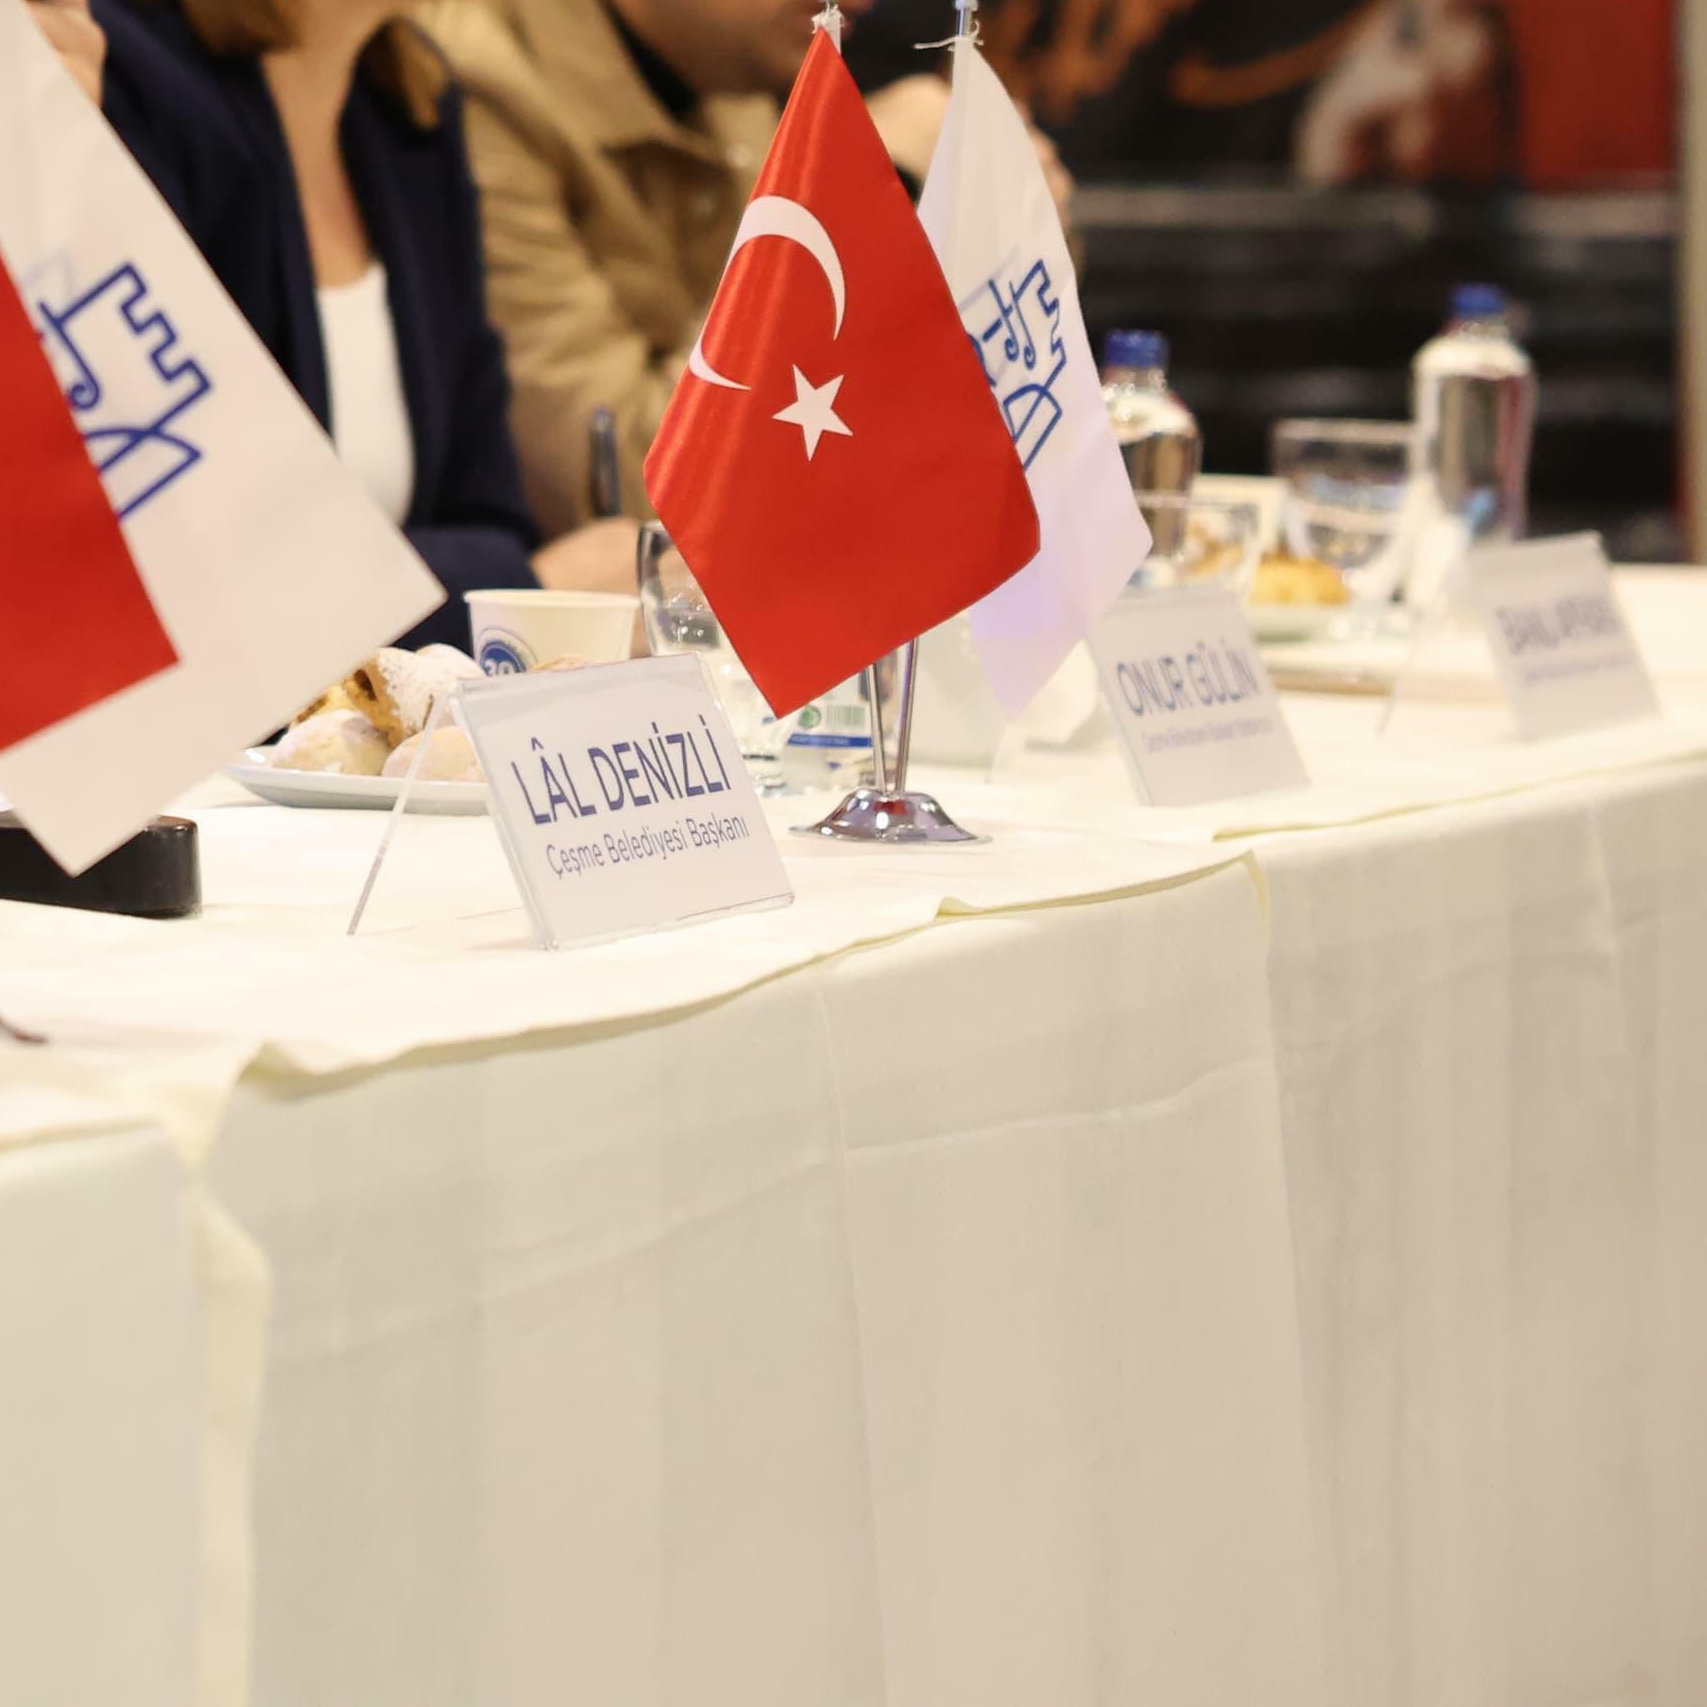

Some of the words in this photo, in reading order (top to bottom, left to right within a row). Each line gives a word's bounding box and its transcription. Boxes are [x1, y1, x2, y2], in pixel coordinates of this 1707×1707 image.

[1116, 656, 1195, 717] ONUR
[511, 737, 597, 825] LÂL
[587, 714, 731, 811] DENİZLİ
[546, 844, 605, 880] Çeşme
[603, 820, 688, 863] Belediyesi
[685, 812, 749, 849] Başkanı
